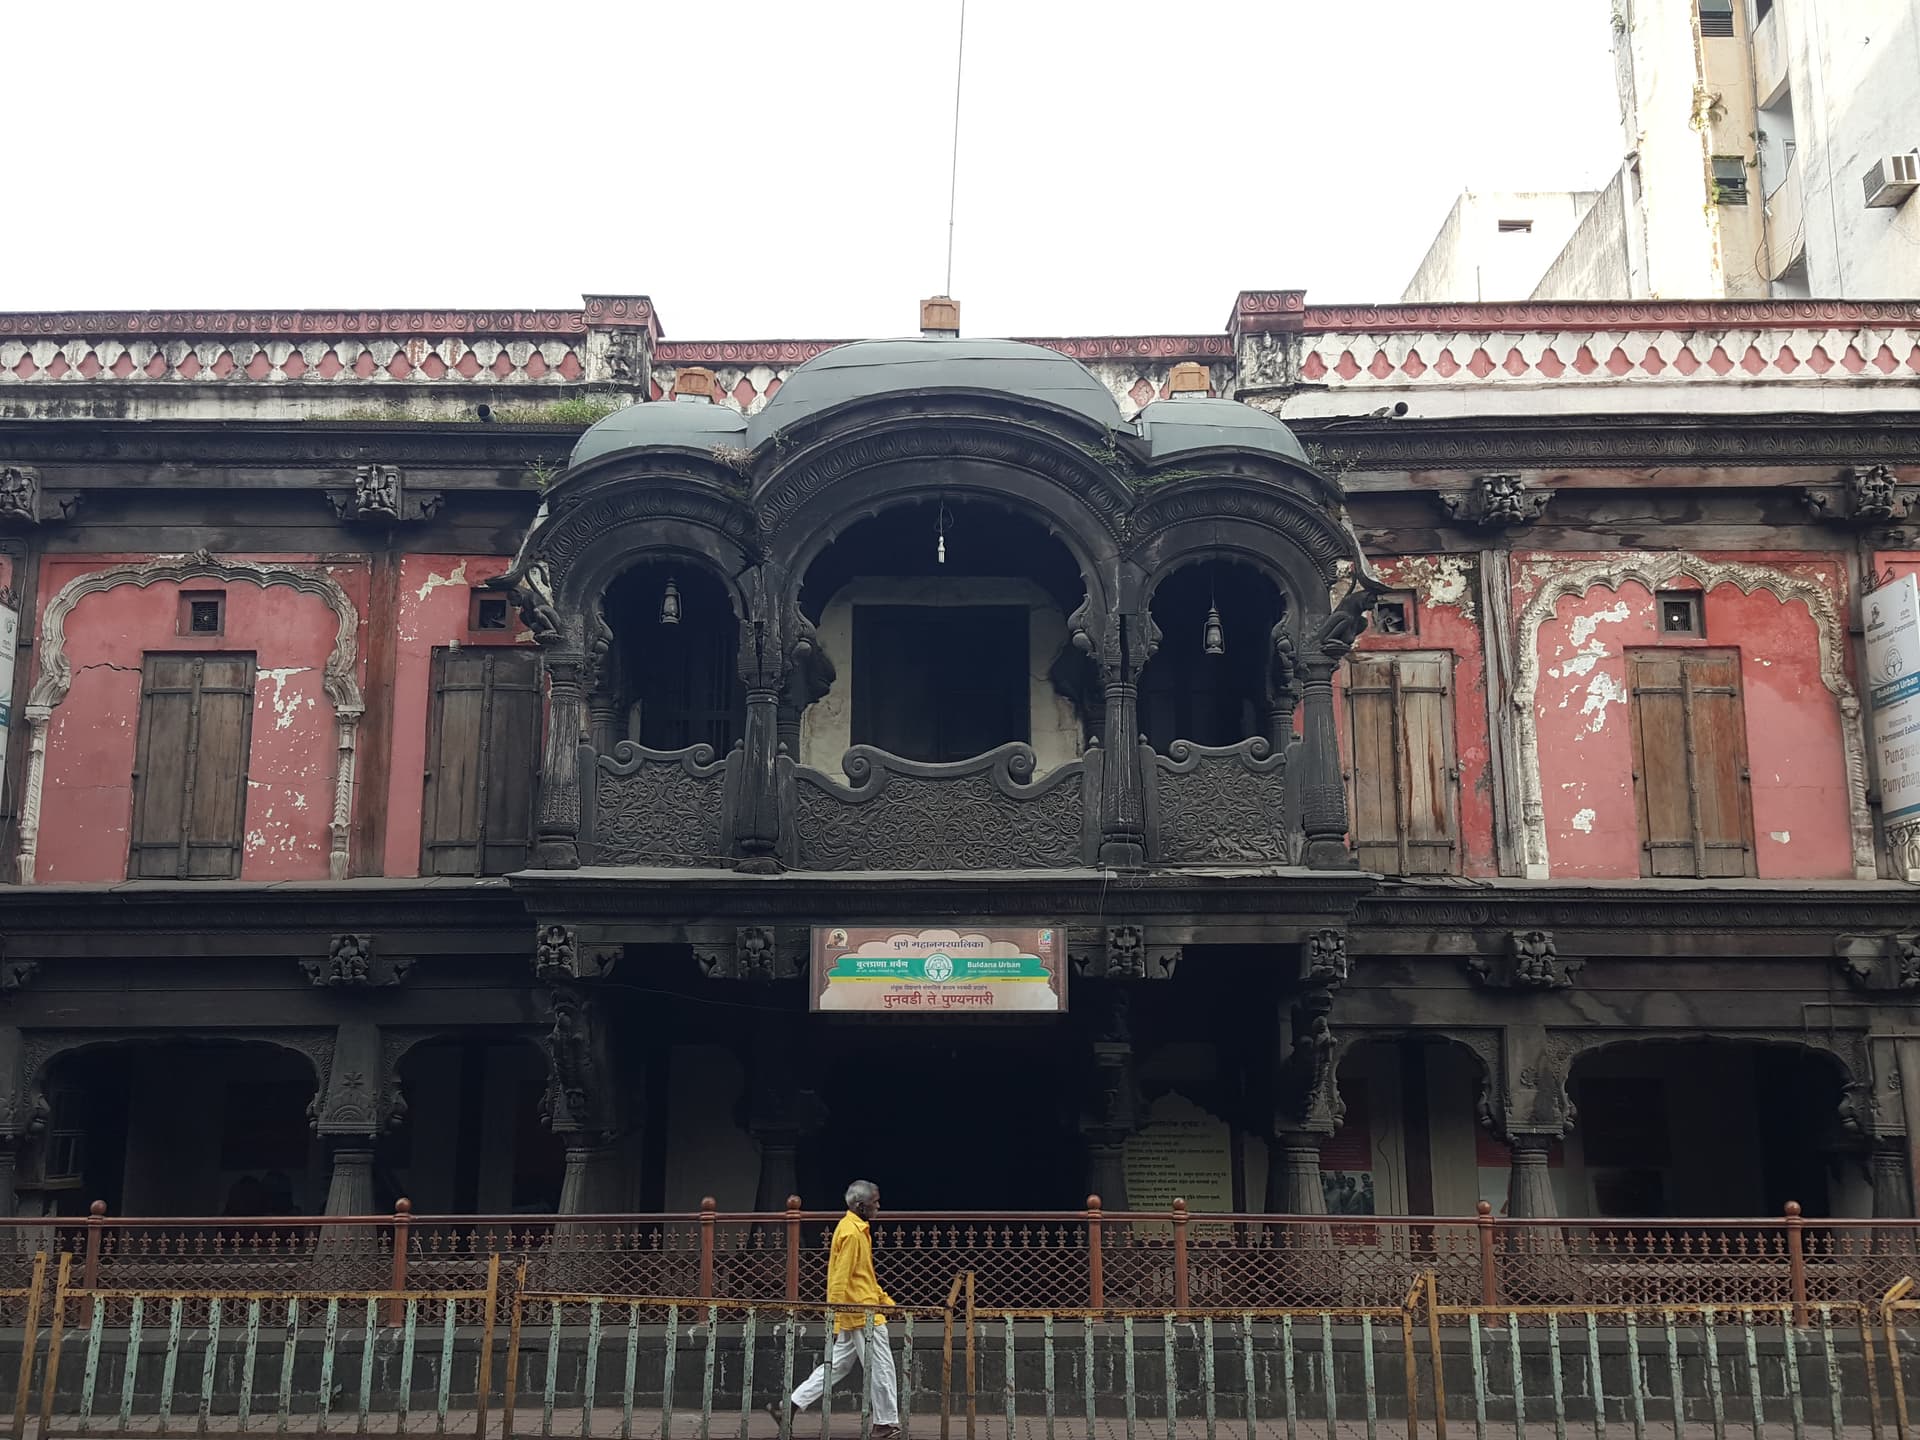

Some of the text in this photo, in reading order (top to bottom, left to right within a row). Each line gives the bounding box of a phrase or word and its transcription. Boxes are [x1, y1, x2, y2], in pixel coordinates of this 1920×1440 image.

[1900, 676, 1919, 689] Urban
[894, 938, 984, 951] पुणे महानगरपालिका
[967, 961, 1021, 969] Buldana Urban
[883, 990, 994, 1009] पुनवडी ते पुण्यनगरी
